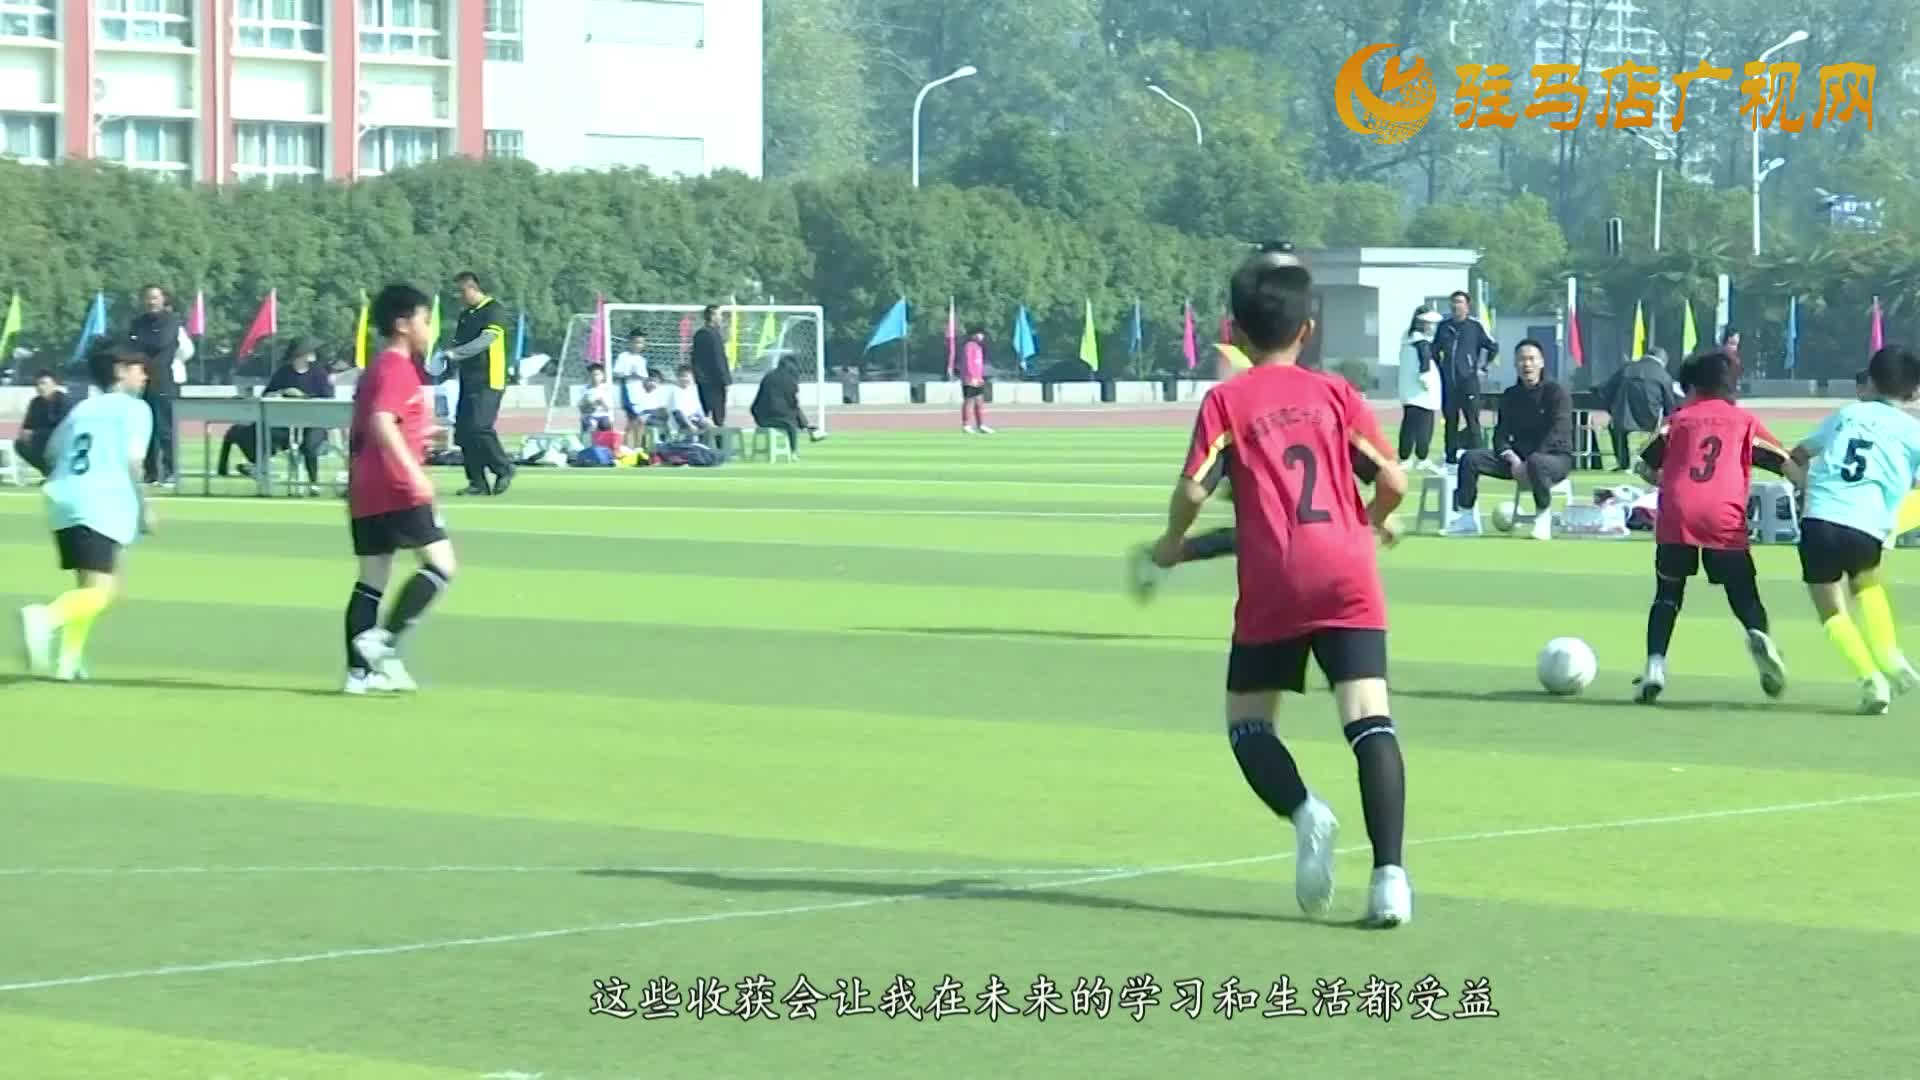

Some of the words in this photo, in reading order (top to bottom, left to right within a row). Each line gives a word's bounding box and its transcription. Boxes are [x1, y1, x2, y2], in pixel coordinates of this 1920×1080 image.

[71, 433, 92, 475] 8
[1689, 436, 1722, 482] 3
[1841, 438, 1873, 482] 5
[1284, 444, 1331, 523] 2
